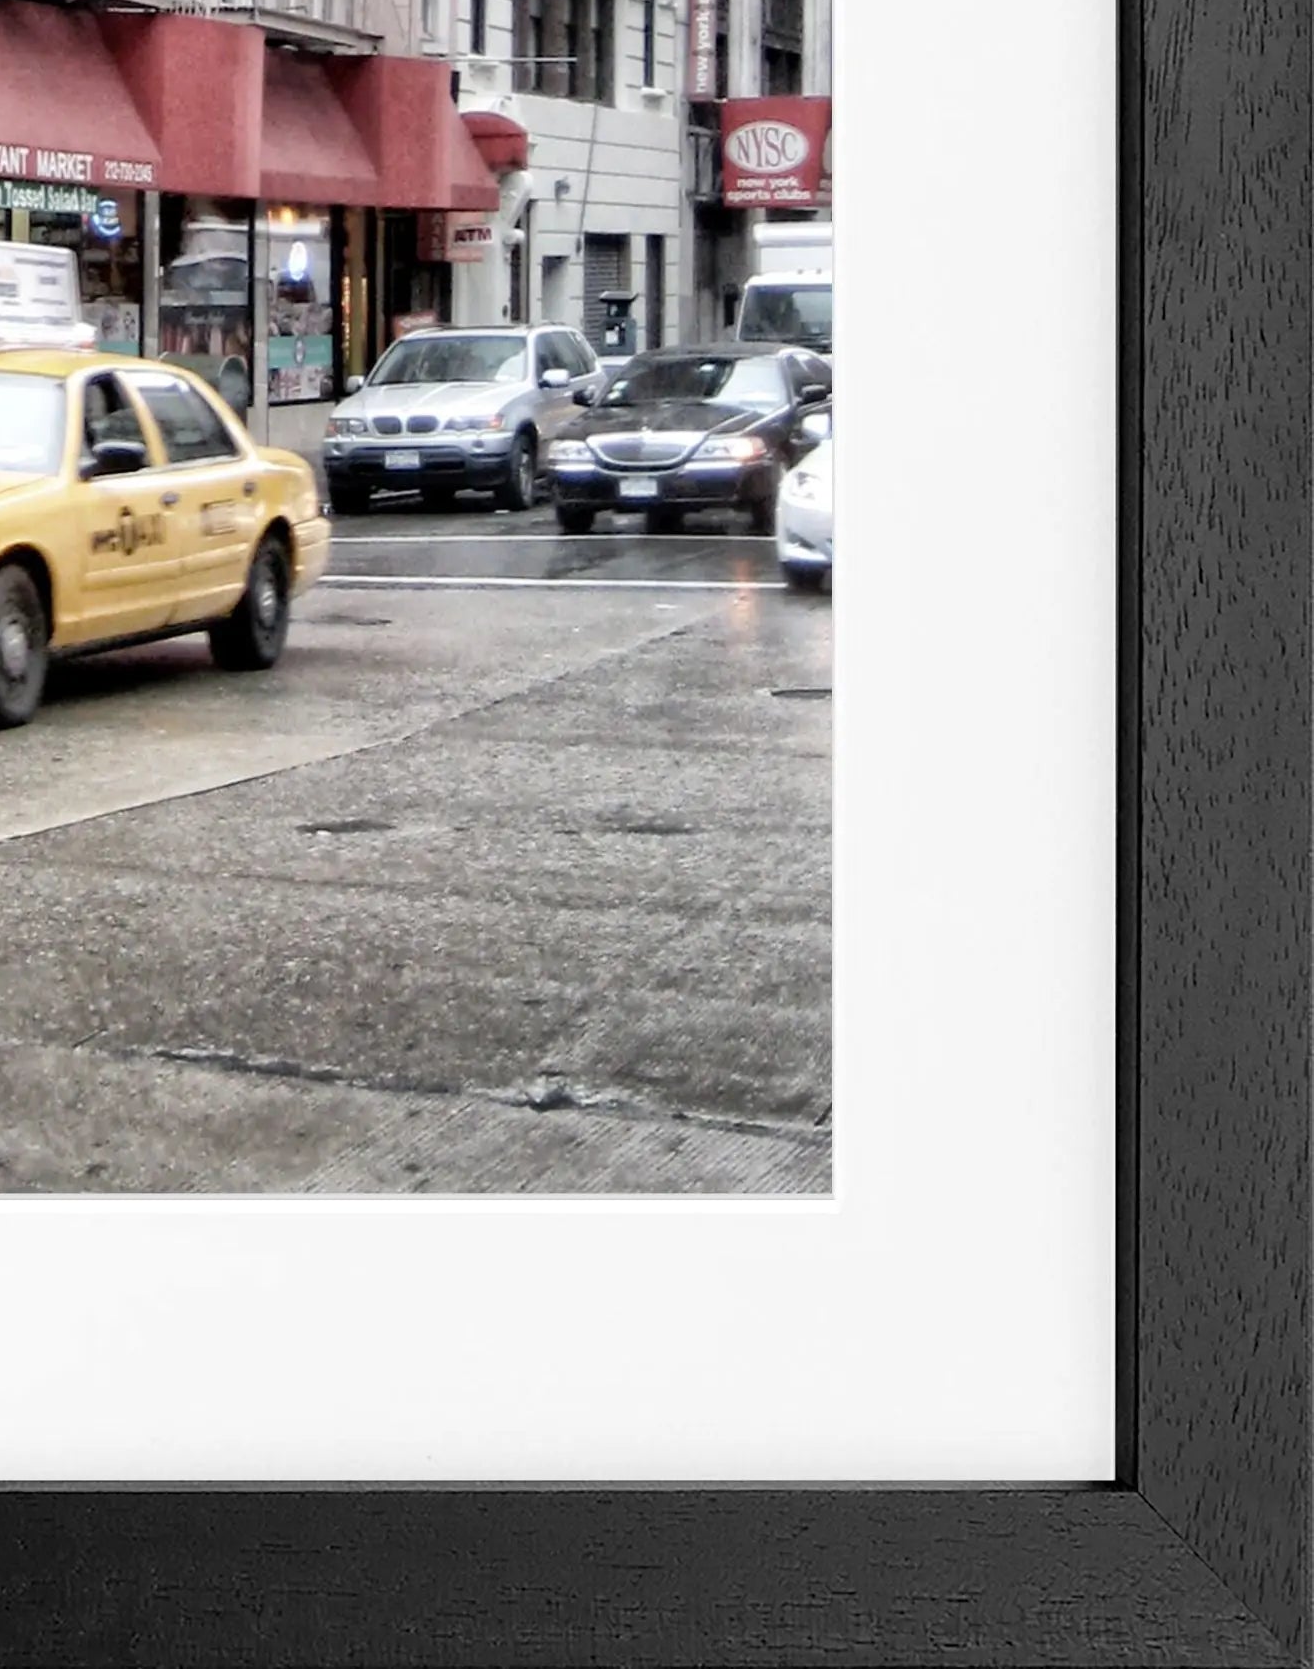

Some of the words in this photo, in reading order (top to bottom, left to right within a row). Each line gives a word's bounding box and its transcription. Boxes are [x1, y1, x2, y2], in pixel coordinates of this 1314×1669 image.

[696, 10, 712, 50] york
[695, 54, 709, 93] new
[735, 126, 799, 169] NYSC
[36, 148, 94, 181] MARKET
[4, 182, 47, 210] Tossed
[727, 190, 771, 204] sports
[774, 188, 811, 201] clubs
[737, 178, 766, 189] new
[769, 176, 799, 191] york
[454, 227, 492, 243] ATM
